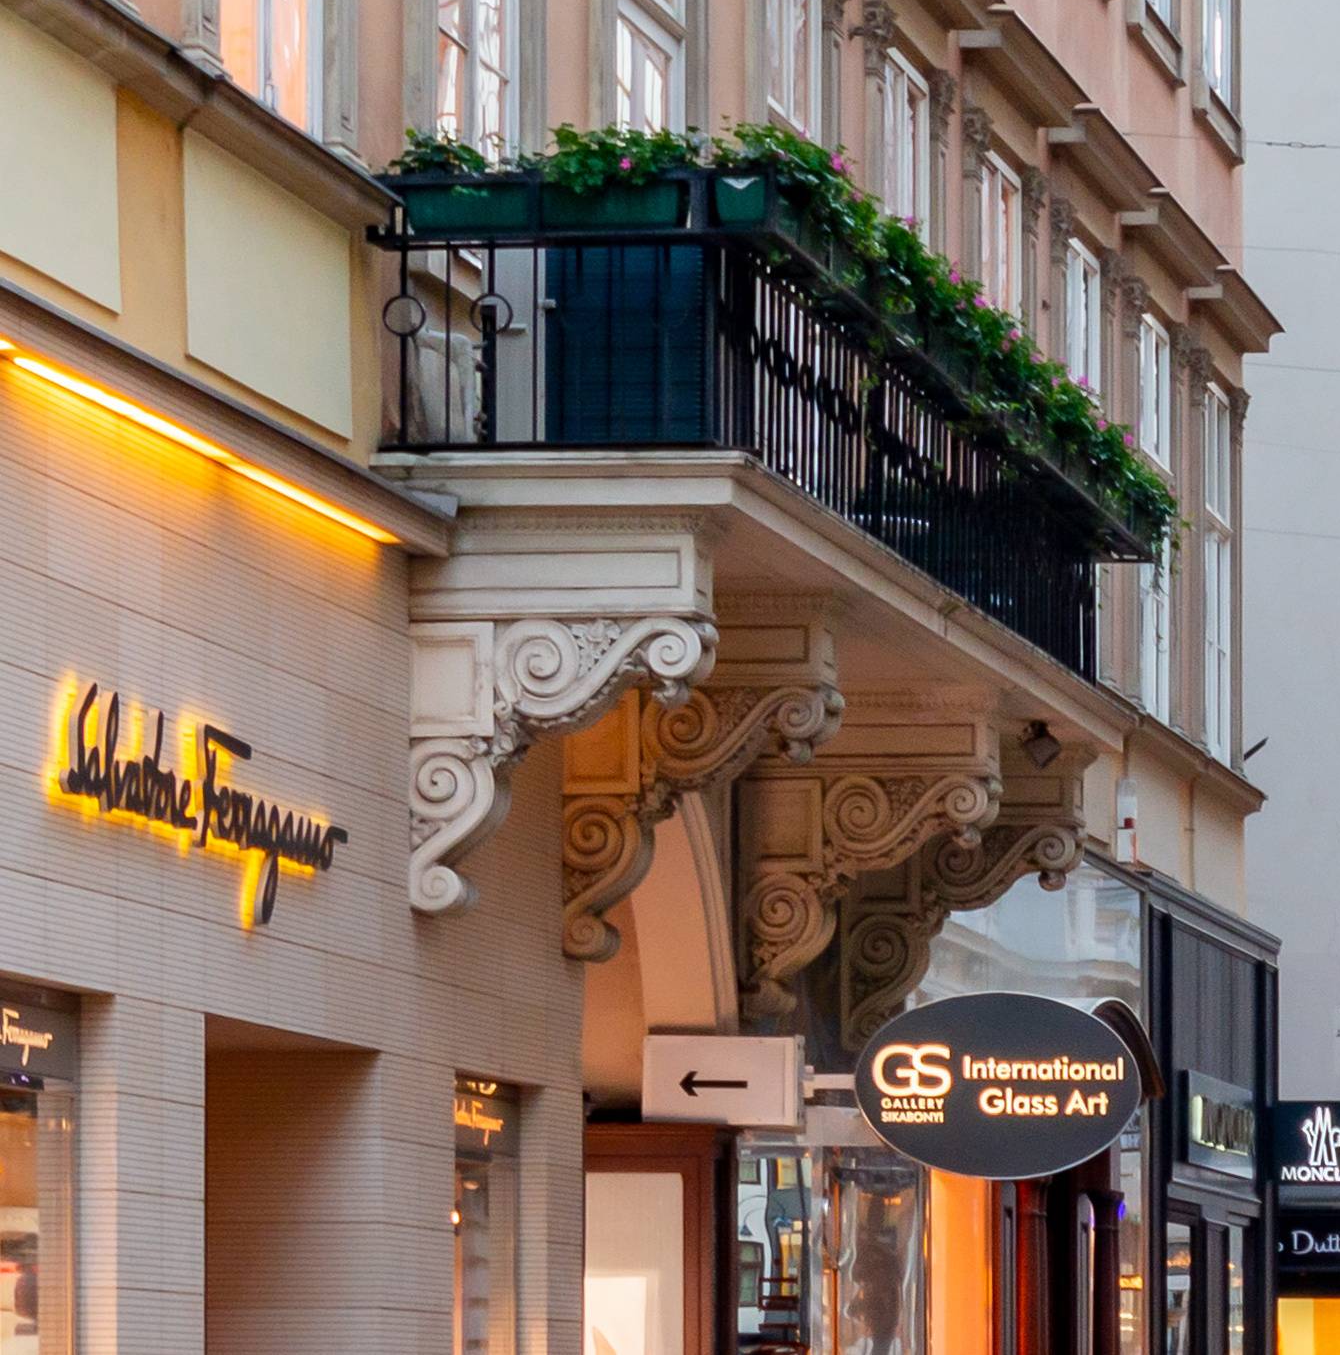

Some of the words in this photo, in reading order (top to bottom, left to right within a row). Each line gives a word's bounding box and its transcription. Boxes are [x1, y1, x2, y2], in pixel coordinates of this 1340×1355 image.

[871, 1043, 953, 1098] GS
[962, 1054, 1125, 1081] International
[880, 1097, 945, 1110] GALLERY
[977, 1086, 1060, 1116] Glass
[1063, 1088, 1110, 1116] Art
